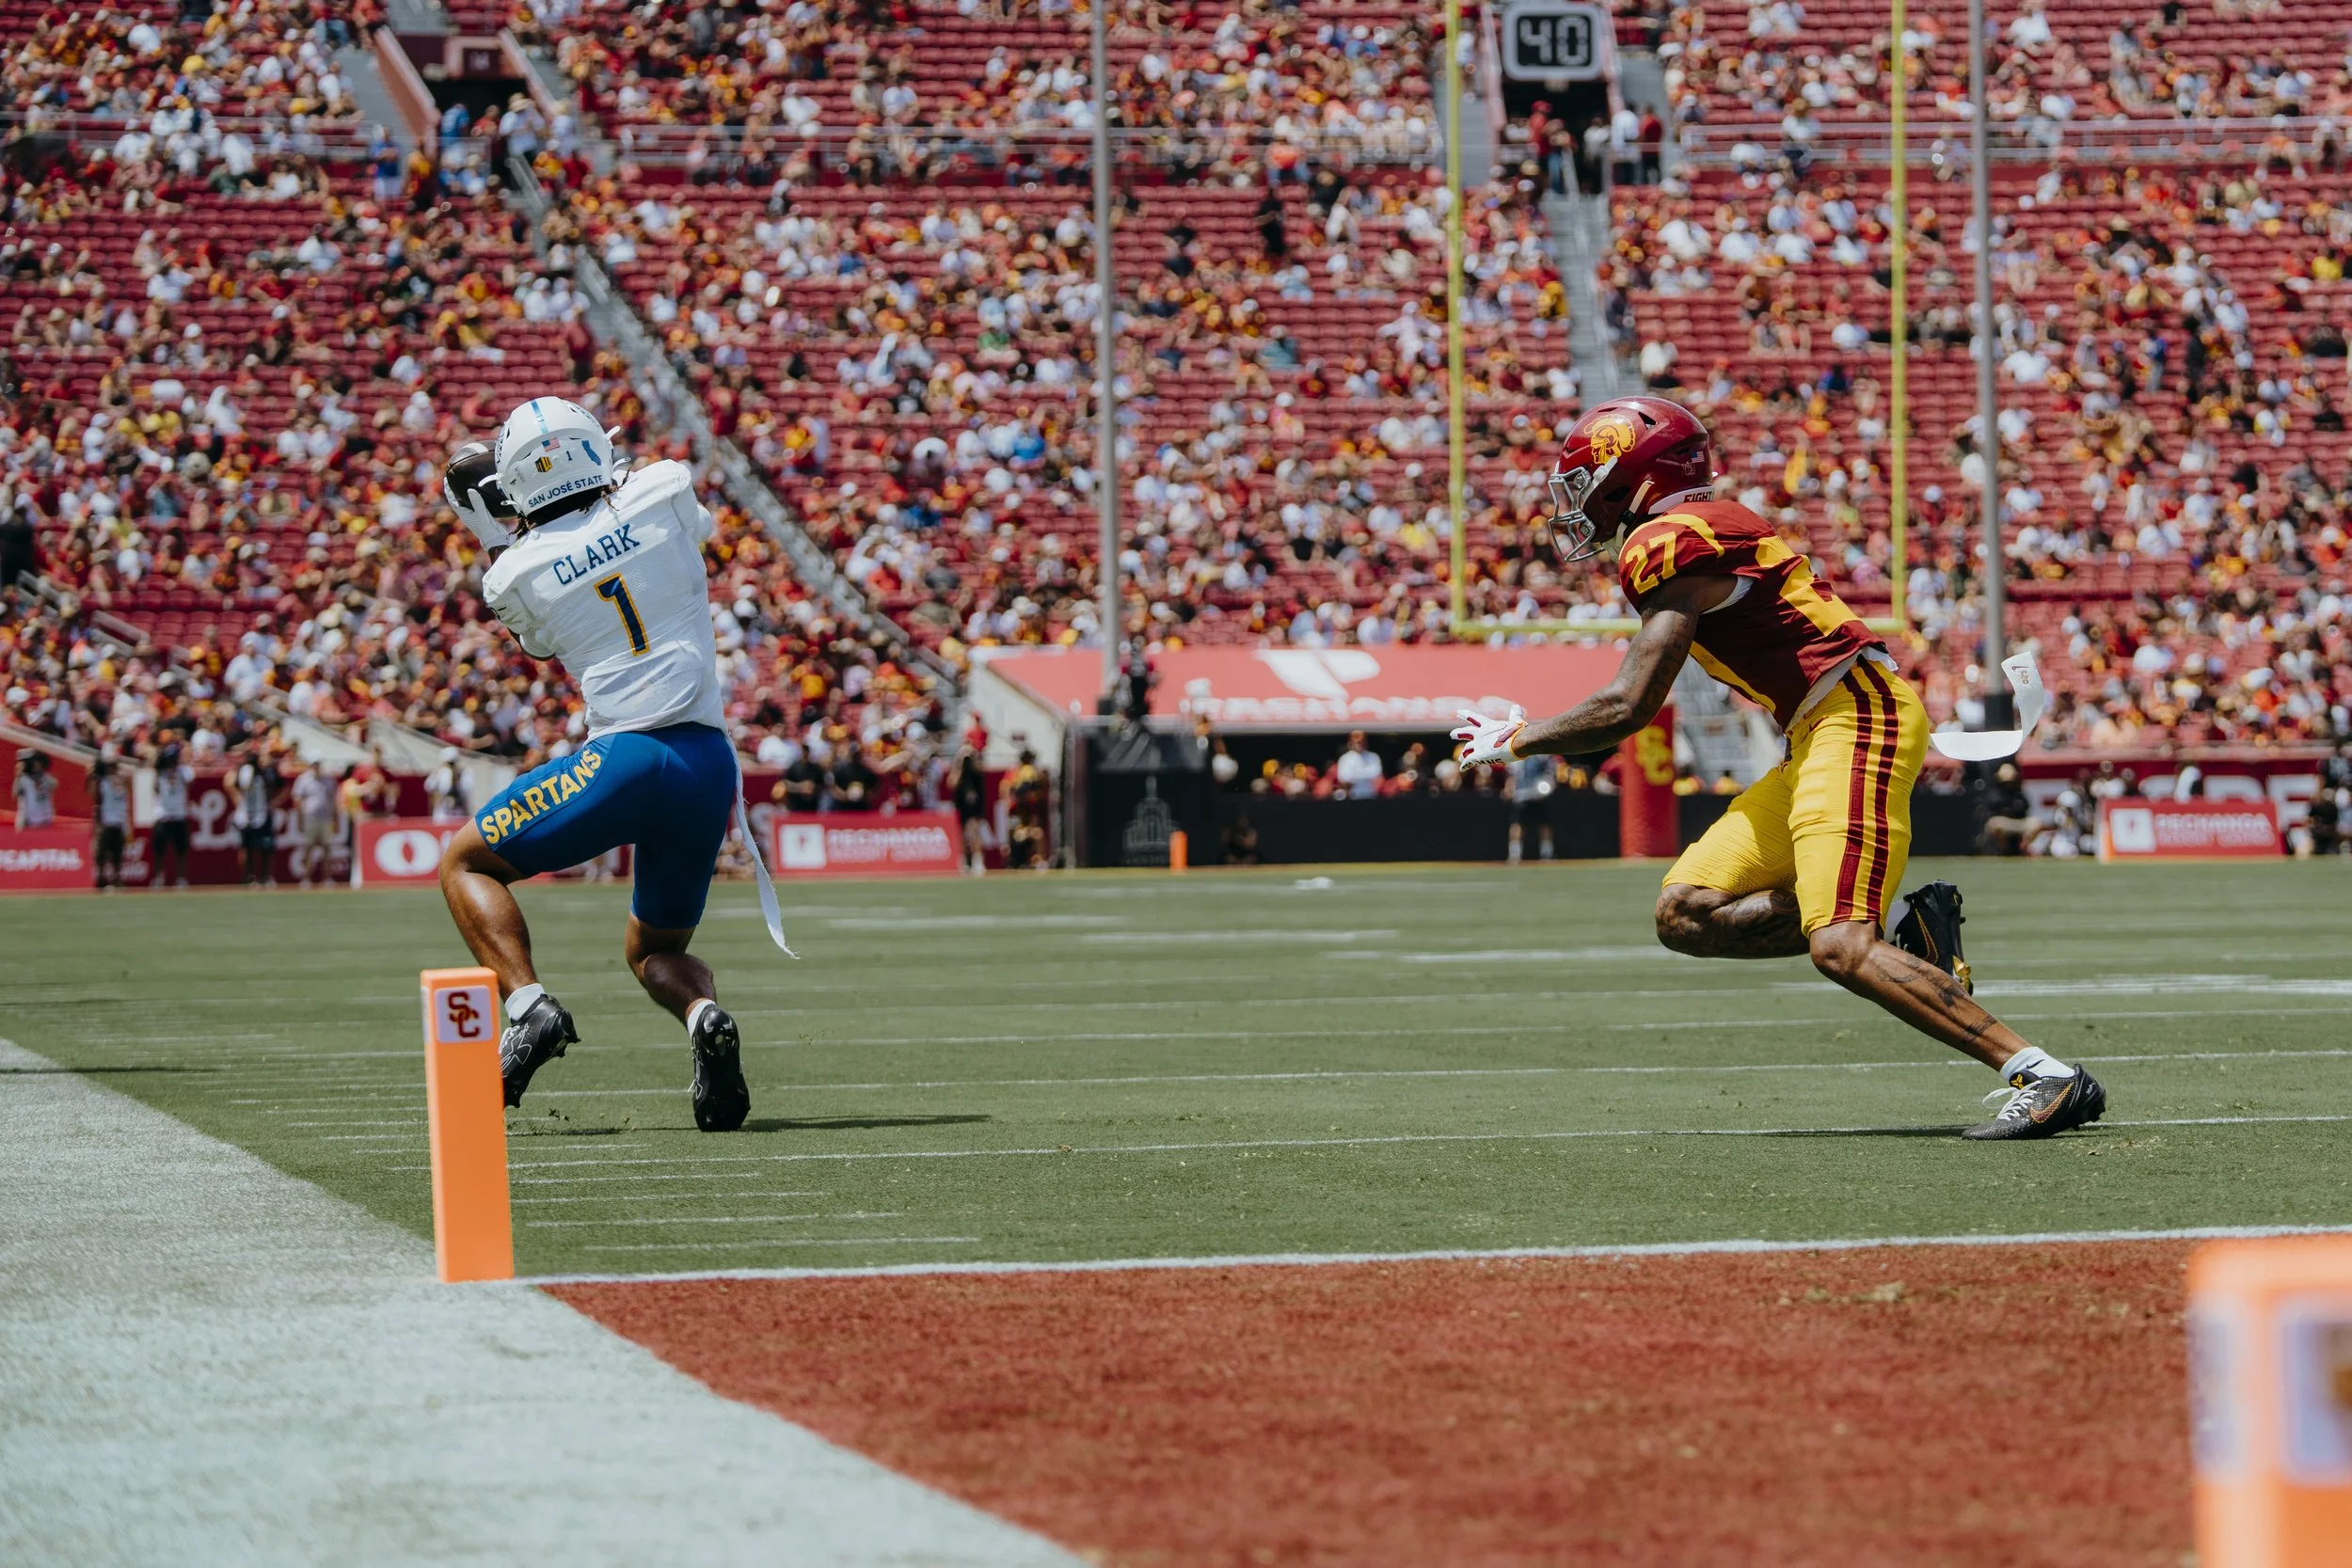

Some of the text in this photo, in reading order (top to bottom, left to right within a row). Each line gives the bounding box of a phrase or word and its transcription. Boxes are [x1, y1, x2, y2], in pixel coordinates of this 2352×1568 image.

[1518, 16, 1589, 65] 40
[565, 451, 573, 462] 1
[528, 475, 604, 508] SAN JOSÉ STATE
[553, 523, 641, 585] CLARK
[1625, 531, 1677, 594] 27
[594, 572, 651, 657] 1
[481, 749, 602, 844] SPARTANS
[447, 990, 481, 1038] SC
